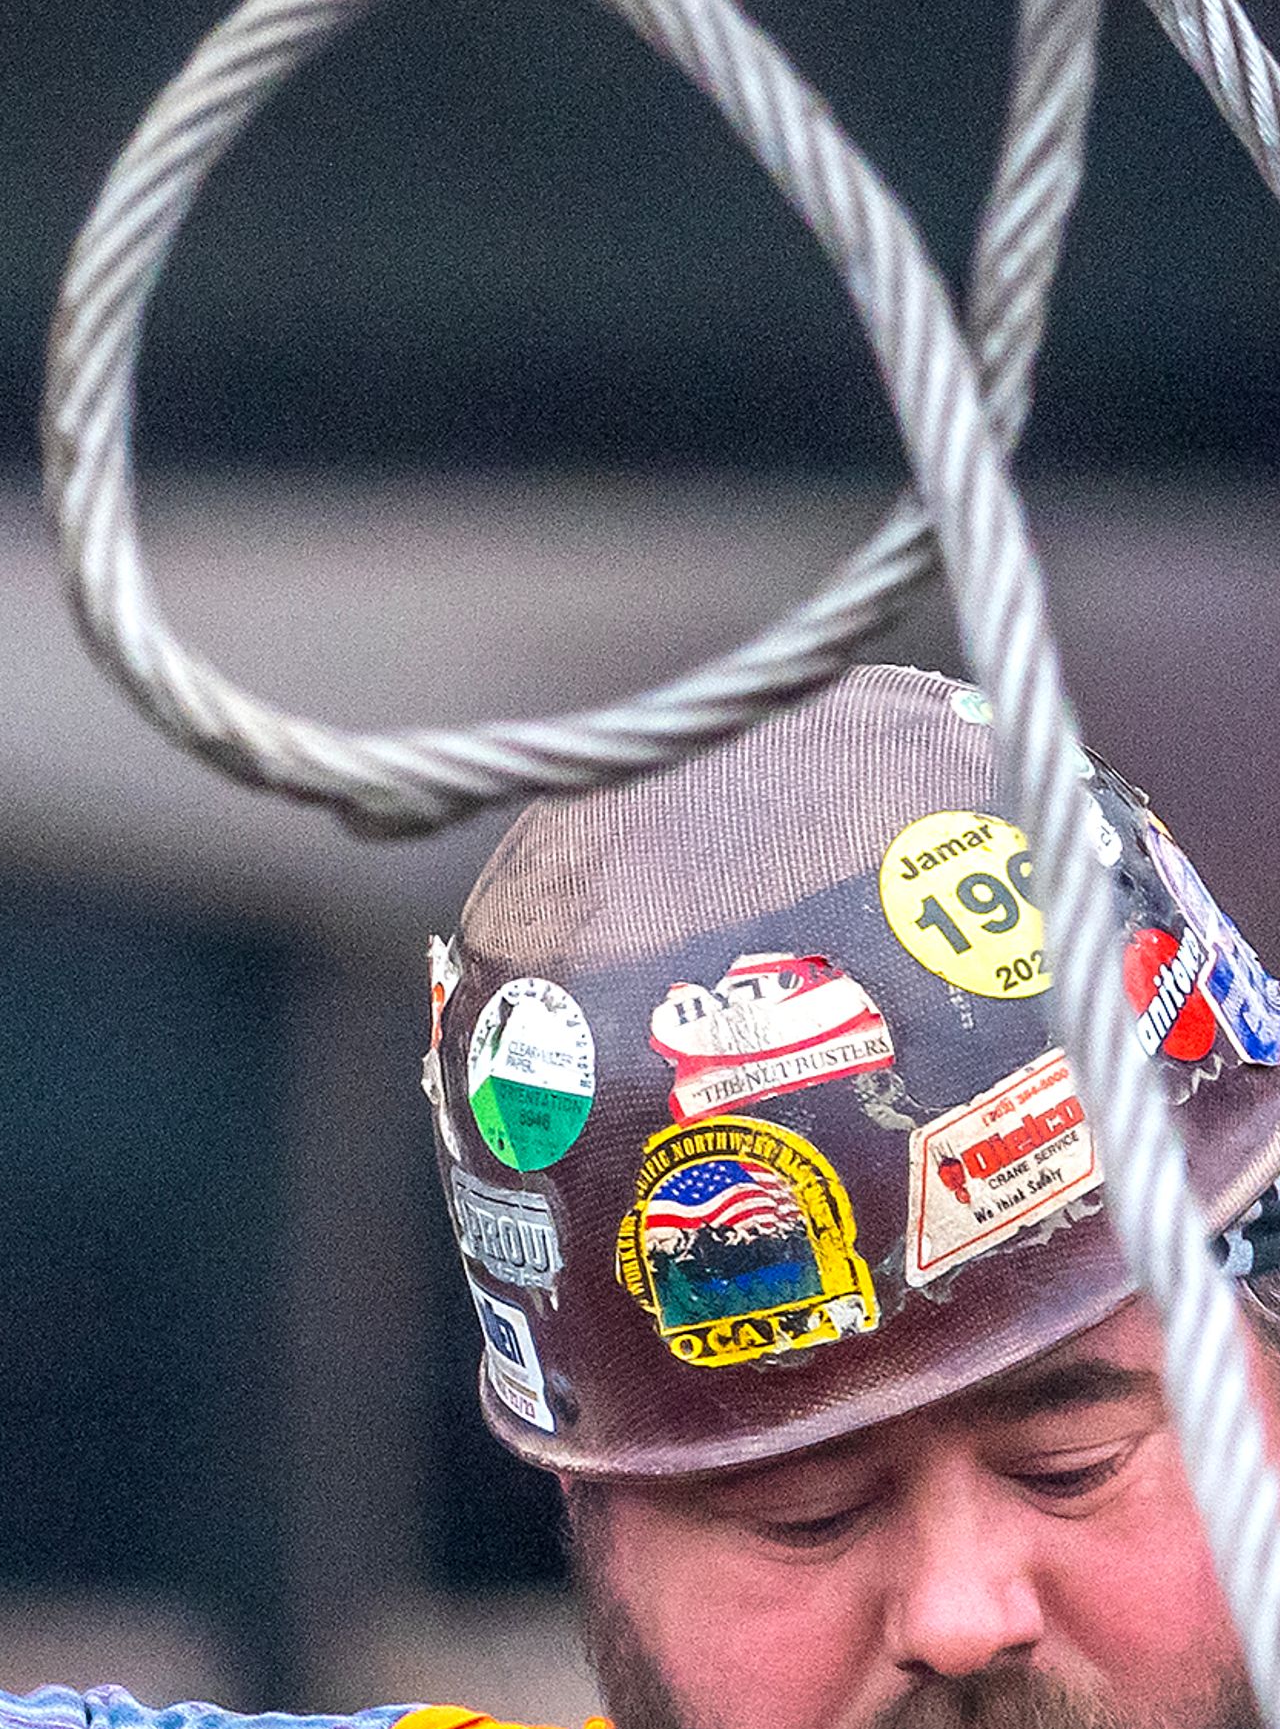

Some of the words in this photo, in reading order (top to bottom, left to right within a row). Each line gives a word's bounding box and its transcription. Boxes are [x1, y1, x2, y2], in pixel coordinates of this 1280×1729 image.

[899, 823, 994, 881] Jamar
[995, 949, 1047, 992] 202
[796, 1036, 891, 1075] BUSTERS
[987, 1159, 1030, 1190] CRANE
[1033, 1129, 1080, 1166] SERVICE
[973, 1207, 995, 1224] We
